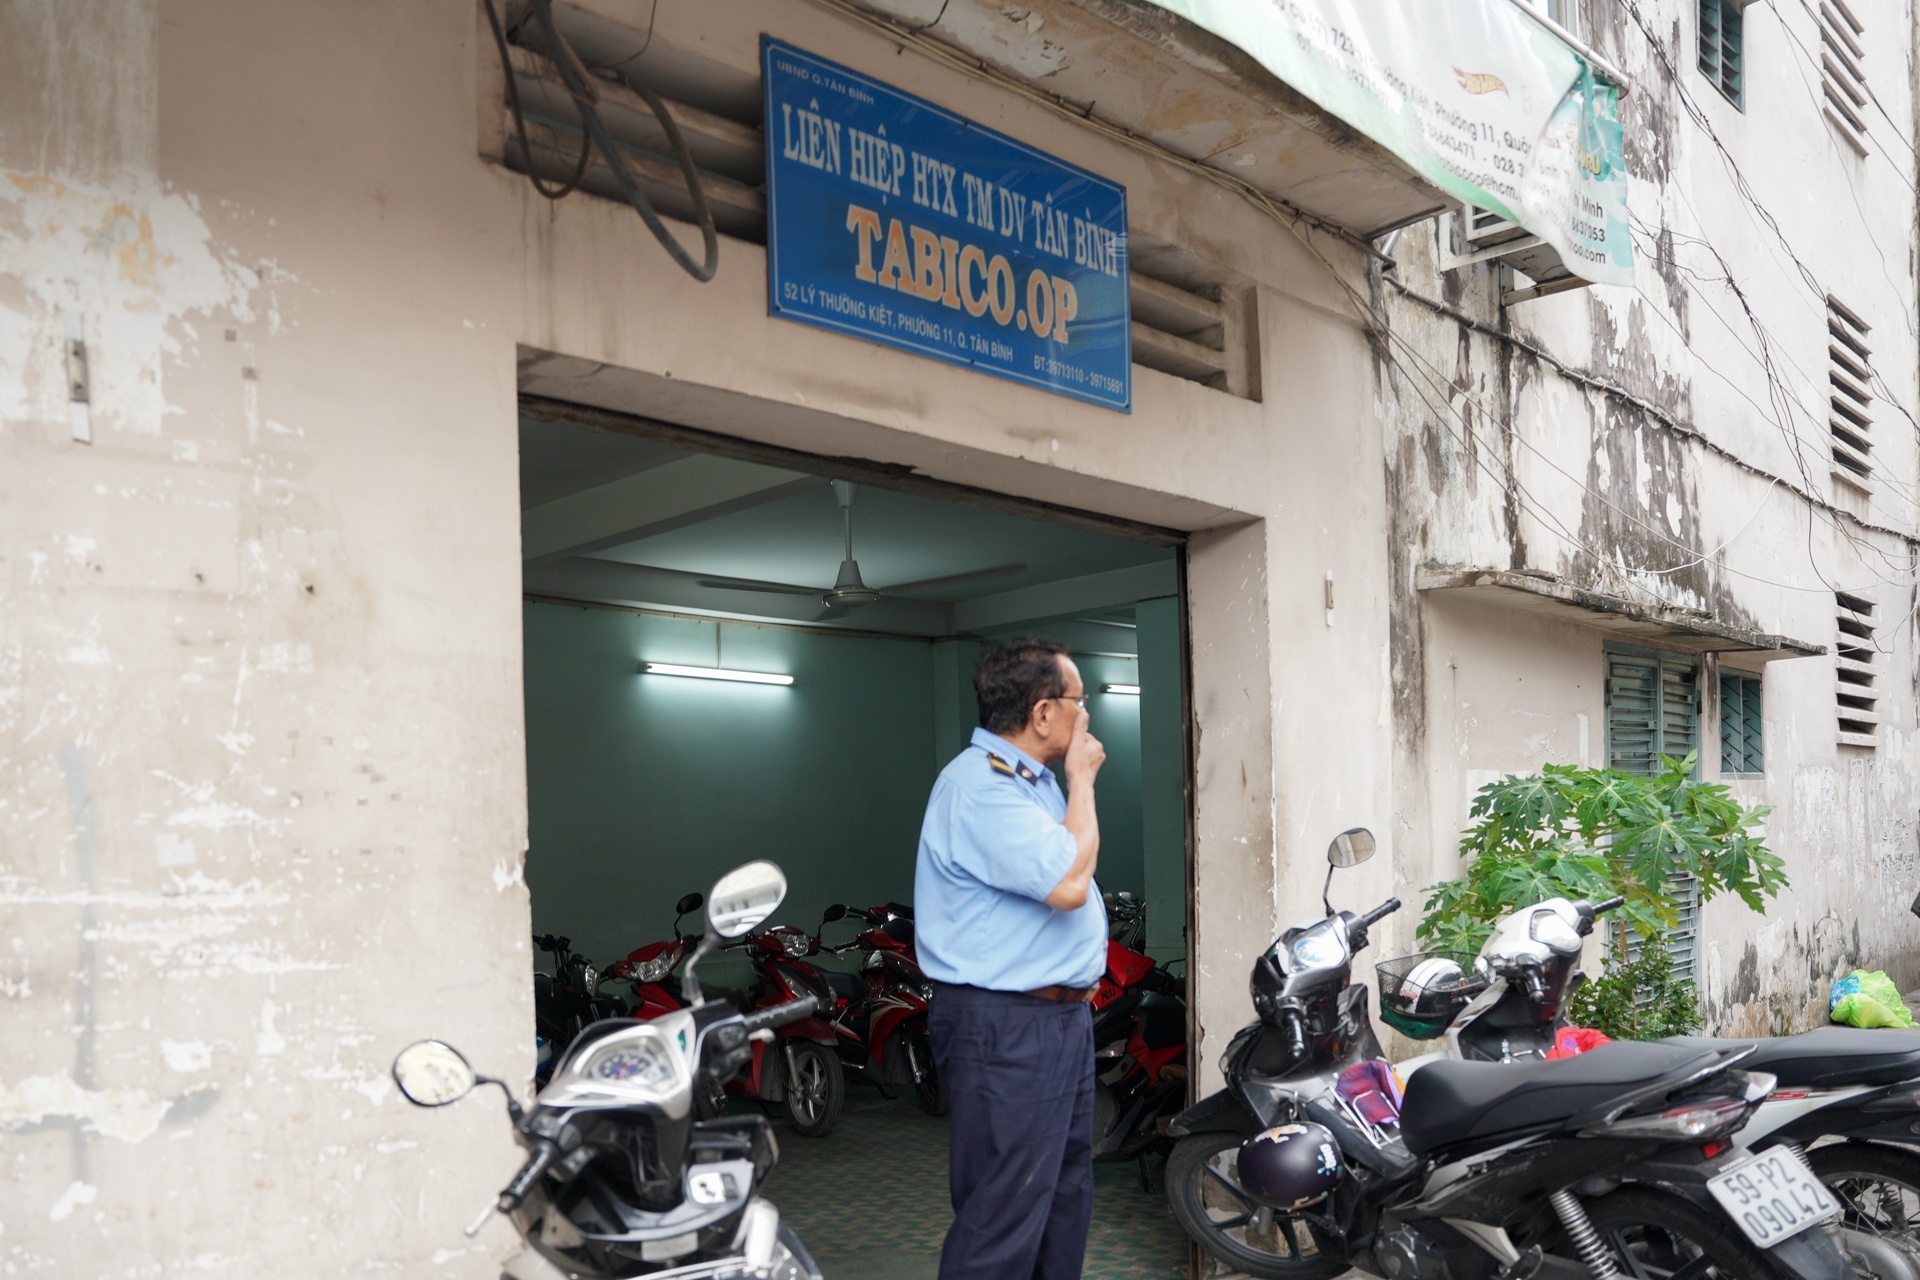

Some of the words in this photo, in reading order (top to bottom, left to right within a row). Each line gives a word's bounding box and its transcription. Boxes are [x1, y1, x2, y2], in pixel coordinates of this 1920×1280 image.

[777, 60, 809, 80] UBND
[812, 73, 846, 94] Q.TÂN
[848, 86, 874, 106] BÌNH
[782, 97, 841, 177] LIÊN
[848, 123, 906, 206] HIỆP
[911, 151, 958, 218] HTX
[962, 172, 995, 232] TM
[999, 185, 1026, 242] DV
[1031, 192, 1069, 260] TÂN
[1074, 207, 1119, 278] BÌNH
[1435, 101, 1477, 142] Phường
[1481, 122, 1501, 148] 11,
[1582, 198, 1603, 219] Minh
[1493, 154, 1515, 176] 028
[846, 203, 1078, 345] TABICO.OP
[784, 281, 798, 300] 52
[800, 284, 816, 305] LÝ
[818, 290, 866, 319] THƯỜNG
[868, 304, 896, 330] KIỆT,
[898, 313, 940, 340] PHƯỜNG
[943, 327, 956, 348] 11,
[957, 331, 968, 349] Q.
[970, 334, 989, 355] TÂN
[991, 340, 1013, 362] BÌNH
[1723, 1157, 1796, 1205] 59-P2
[1743, 1182, 1830, 1240] 090.42
